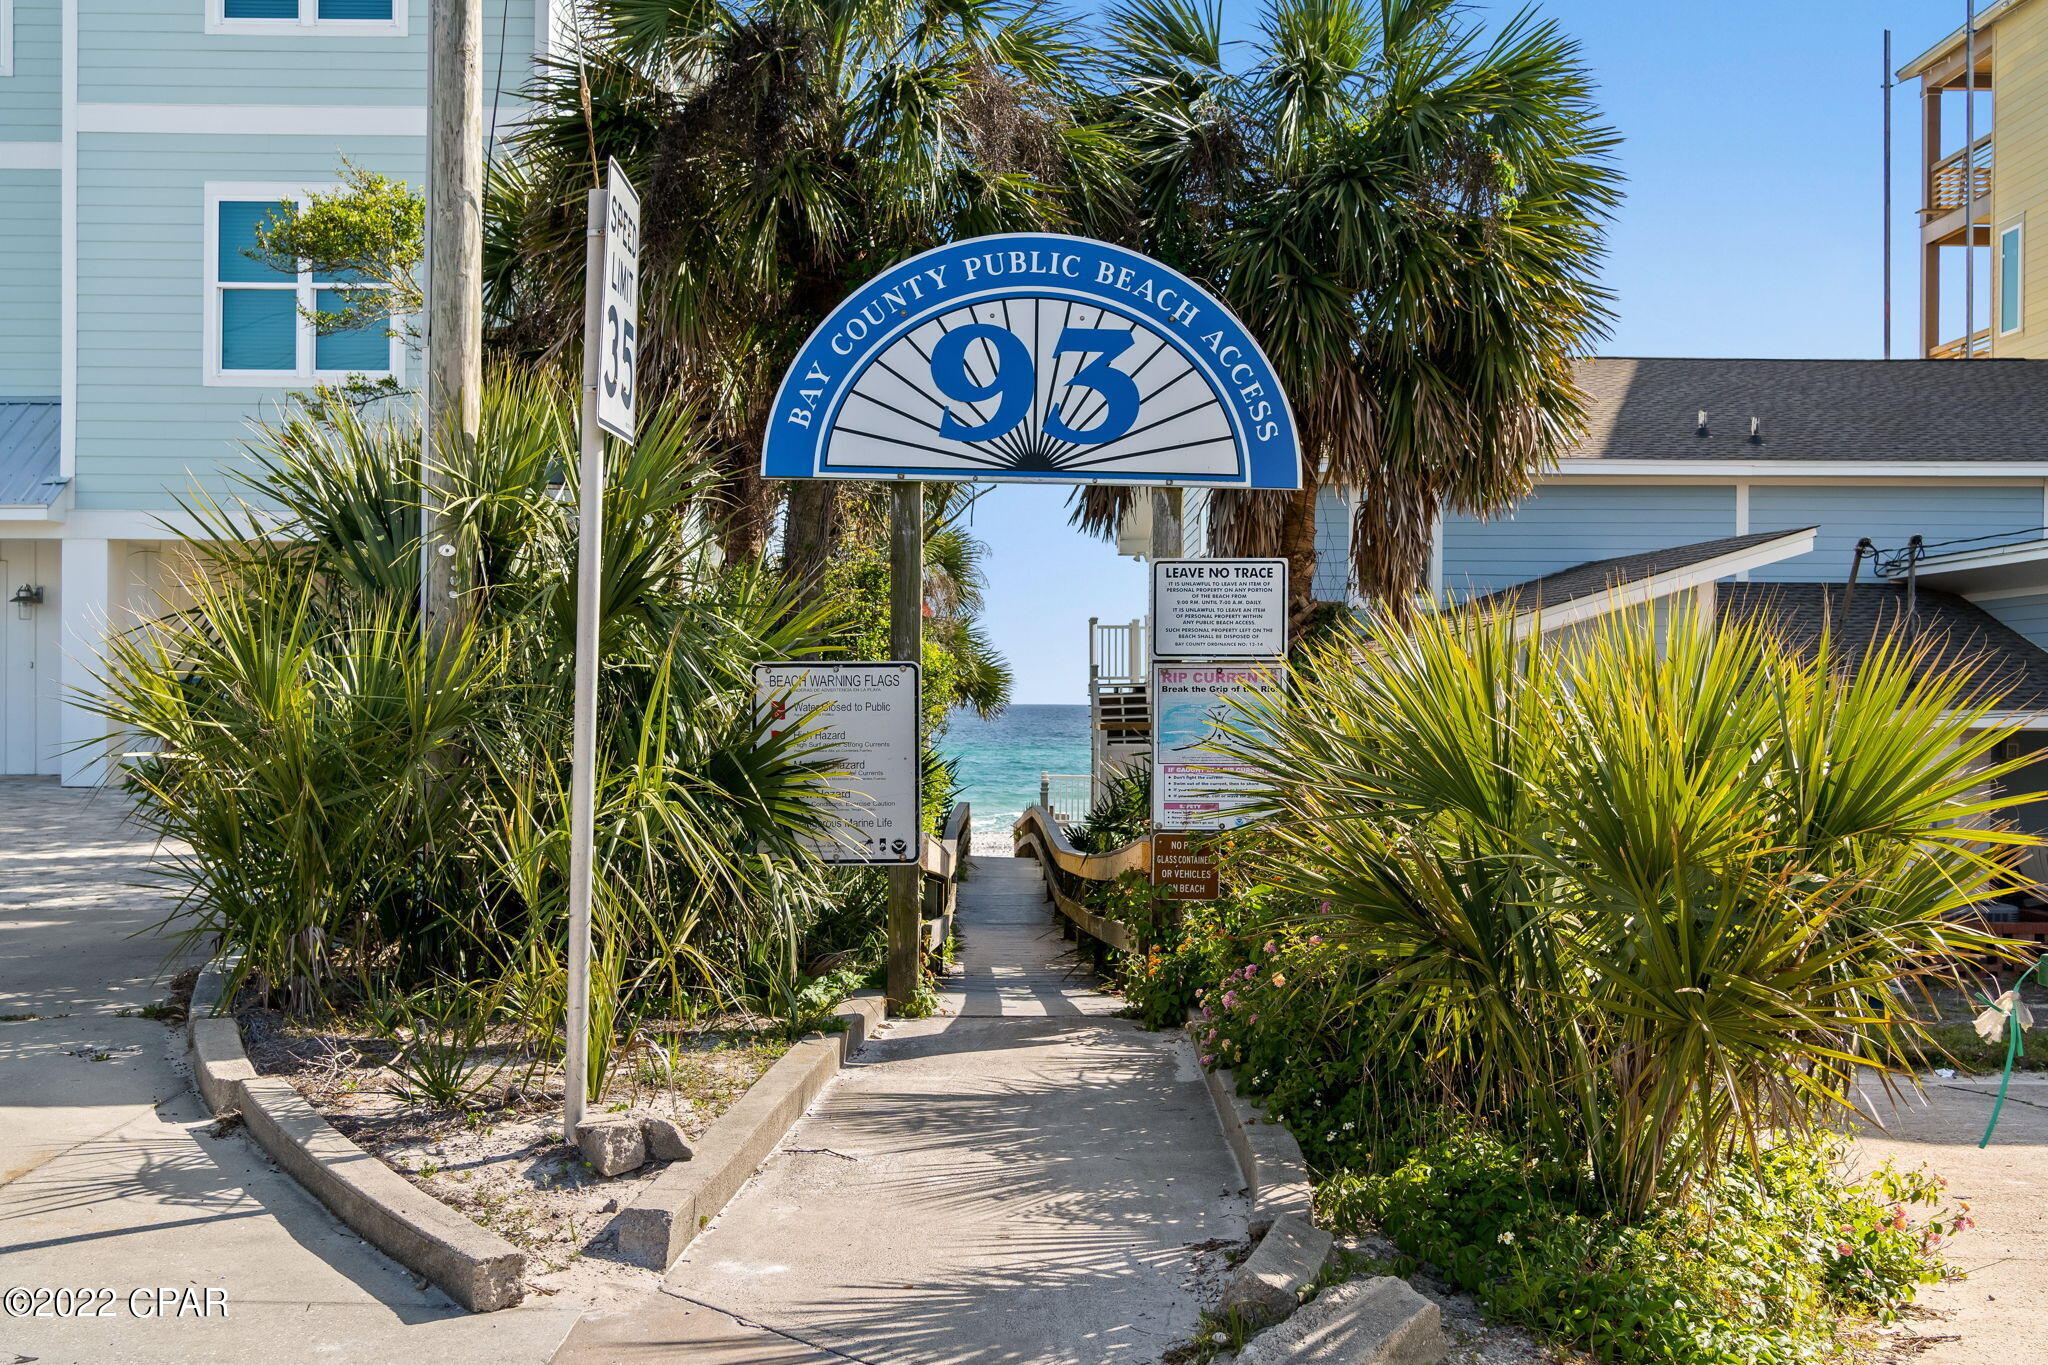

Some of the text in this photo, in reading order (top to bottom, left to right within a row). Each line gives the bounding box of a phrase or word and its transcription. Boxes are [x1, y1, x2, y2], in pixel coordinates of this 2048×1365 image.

[611, 195, 637, 260] SPEED
[611, 252, 634, 307] LIMIT
[788, 251, 1280, 442] BAY COUNTY PUBLIC BEACH ACCESS
[604, 304, 634, 410] 35
[930, 324, 1141, 445] 93
[1166, 568, 1273, 578] LEAVE NO TRACE
[769, 674, 900, 687] BEACH WARNING FLAGS
[1161, 673, 1188, 683] RIP
[1209, 686, 1228, 694] Grip
[855, 703, 862, 712] to
[865, 702, 890, 712] Public
[815, 731, 846, 740] Hazard
[833, 760, 865, 769] azard
[800, 818, 892, 829] angerous Marine Life
[1171, 841, 1181, 849] NO
[1157, 856, 1177, 864] GLASS
[1174, 870, 1211, 878] VEHICLES
[1180, 884, 1205, 892] BEACH
